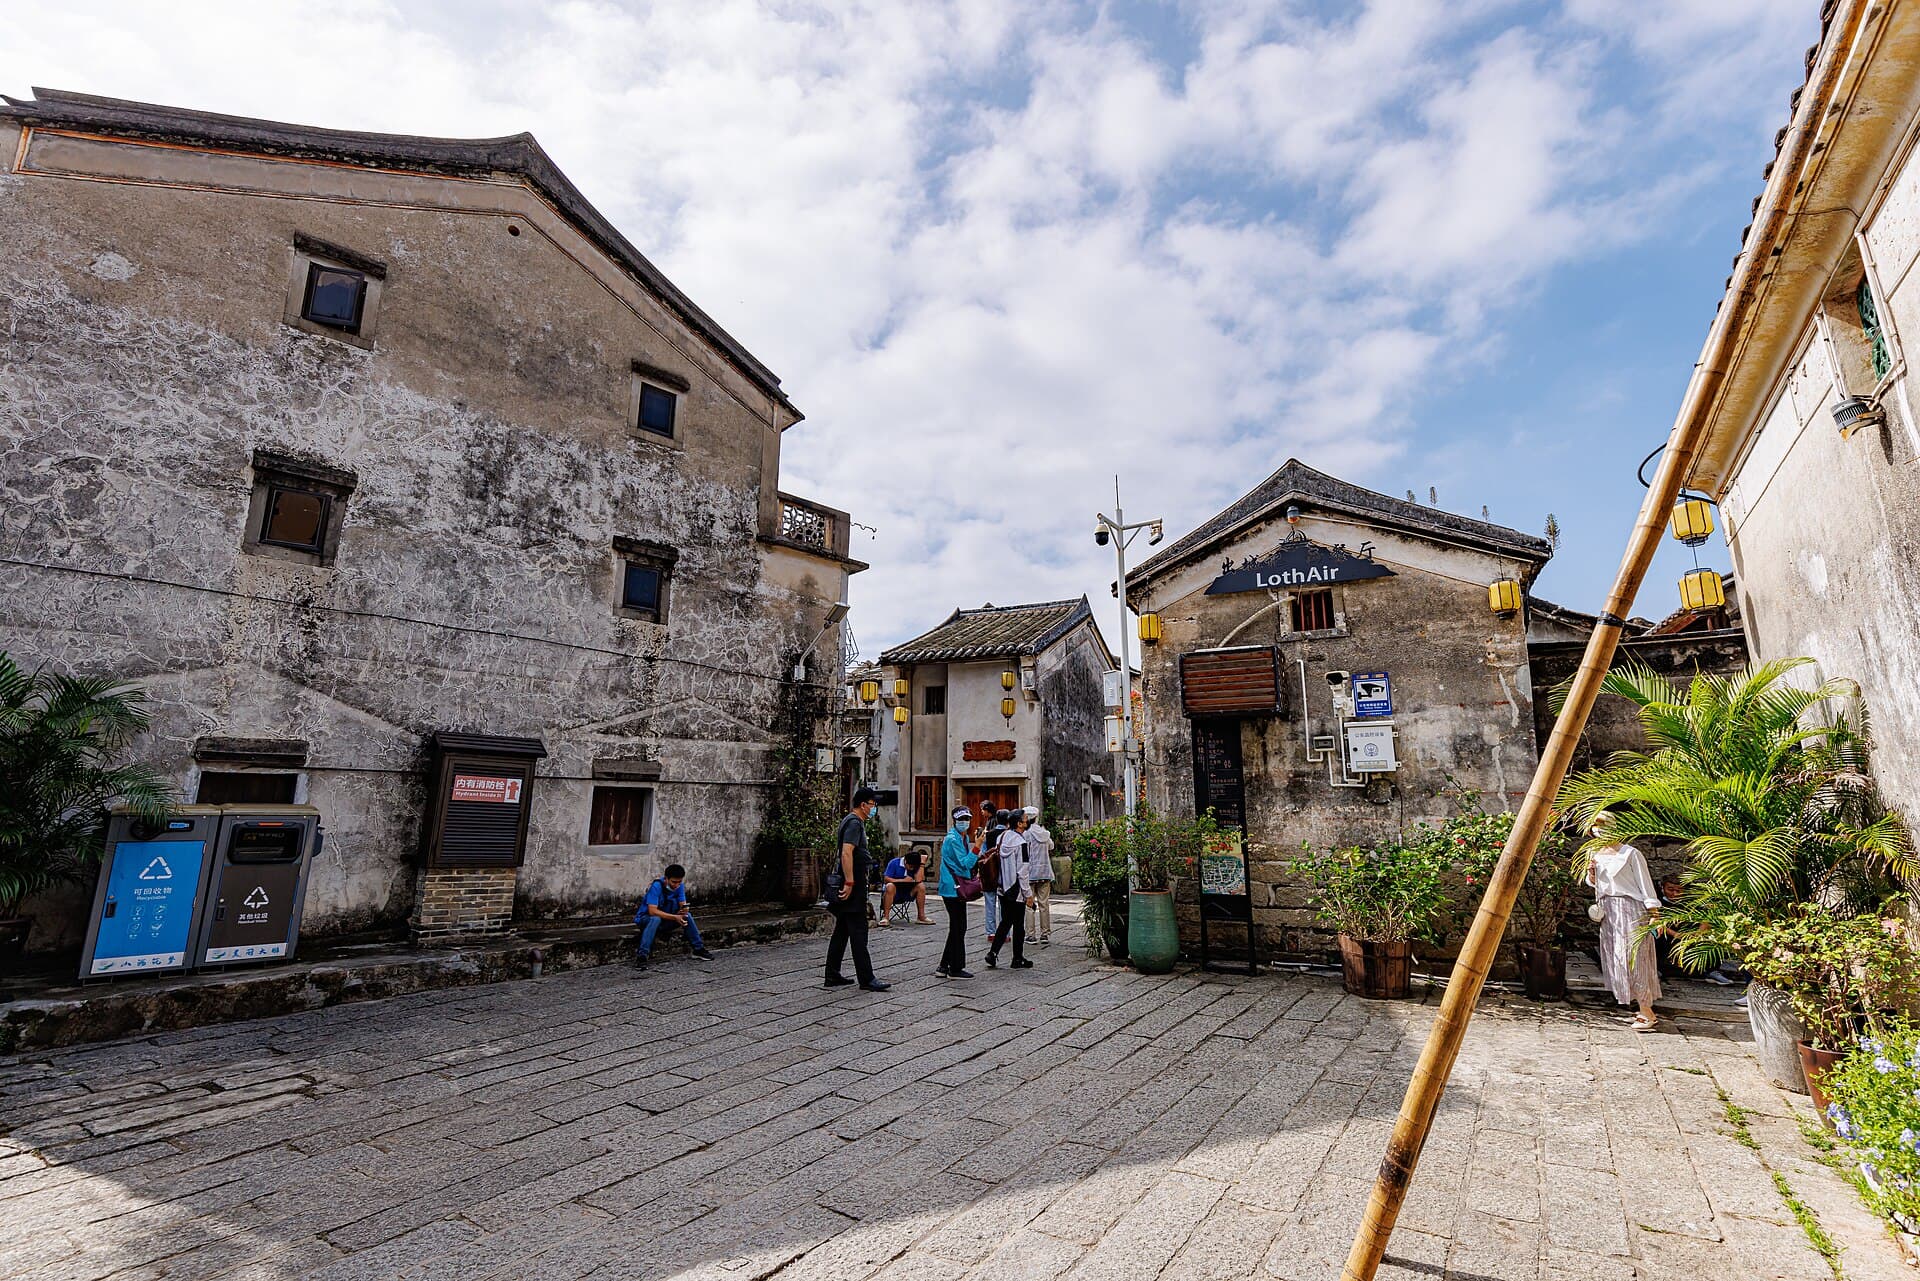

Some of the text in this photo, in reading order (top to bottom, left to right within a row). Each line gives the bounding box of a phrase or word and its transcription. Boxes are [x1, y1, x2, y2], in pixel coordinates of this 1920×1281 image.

[1256, 565, 1339, 588] LothAir
[456, 779, 505, 790] 内有消防栓
[134, 887, 172, 895] 可回收物
